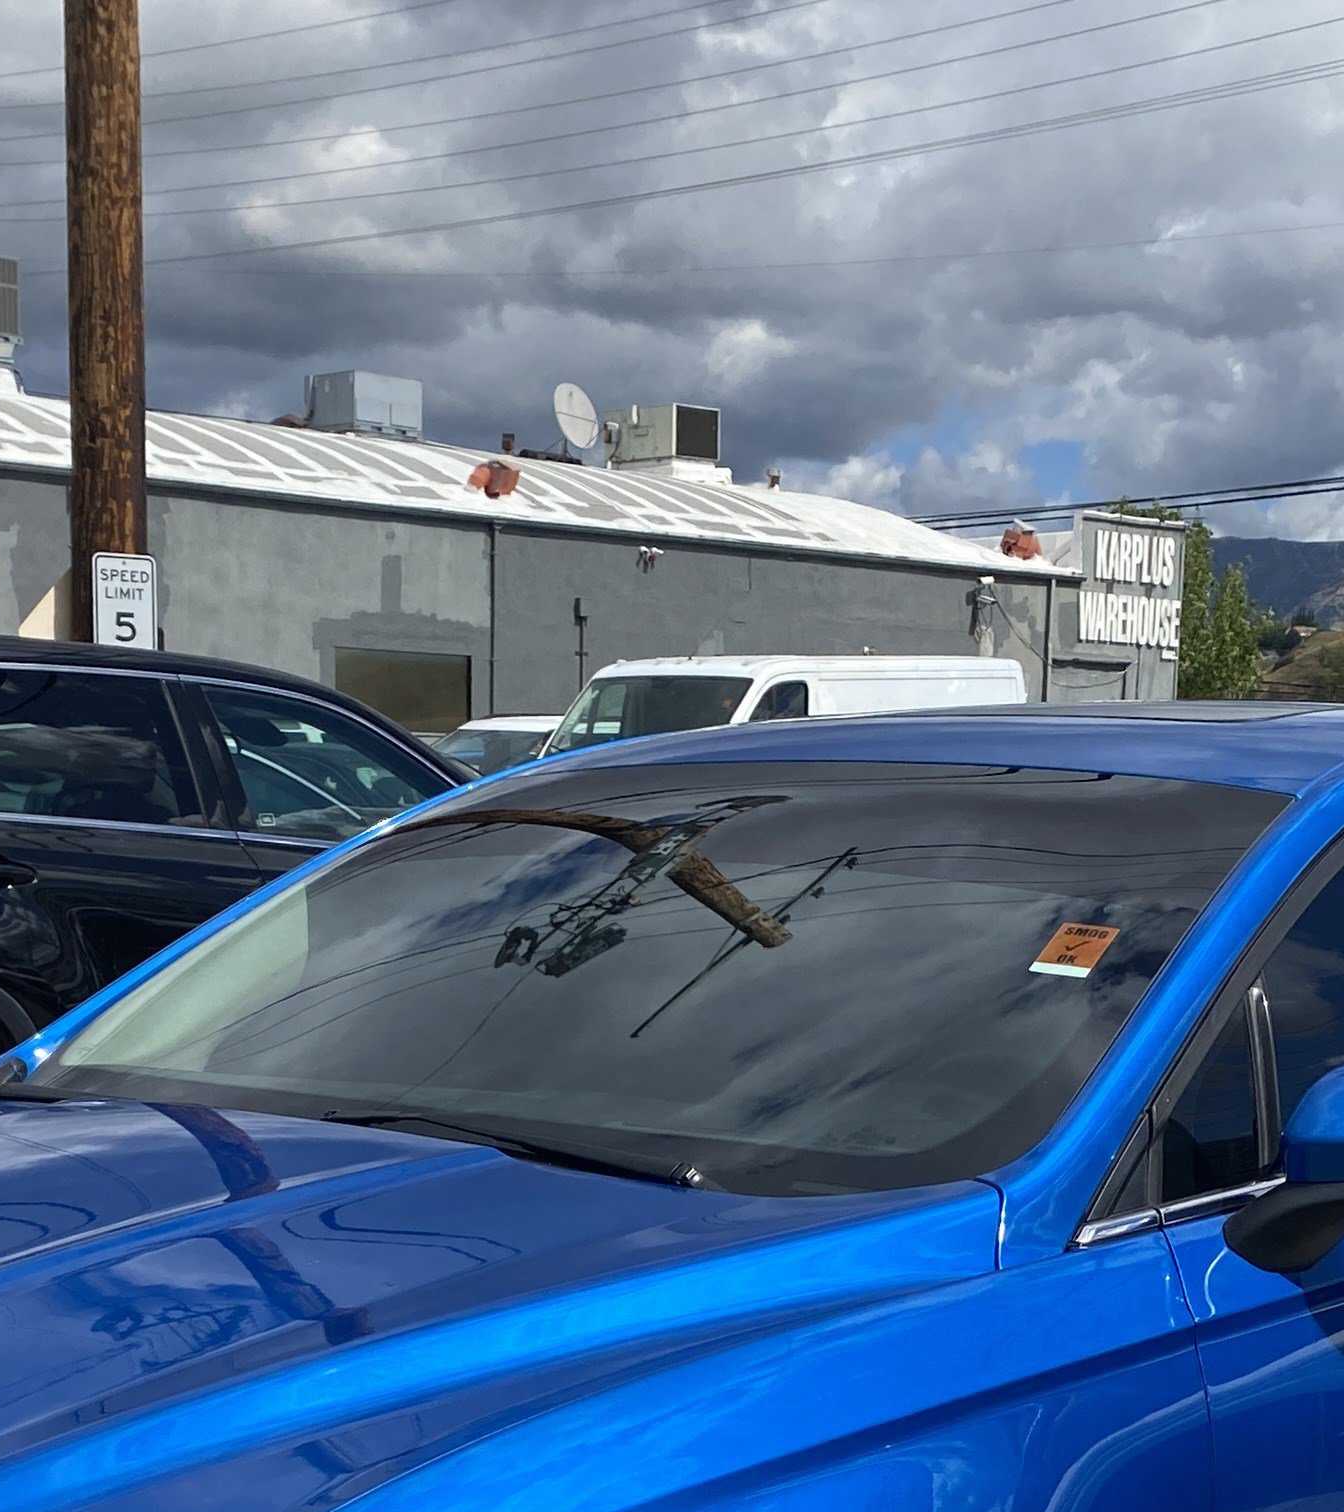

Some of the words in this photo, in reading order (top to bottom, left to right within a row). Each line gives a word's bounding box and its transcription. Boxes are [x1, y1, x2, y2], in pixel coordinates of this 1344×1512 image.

[1096, 529, 1175, 586] KARPLUS
[100, 568, 150, 583] SPEED
[105, 586, 144, 600] LIMIT
[115, 612, 136, 641] 5
[1079, 591, 1182, 647] WAREHOUSE
[1065, 927, 1109, 939] SMOG
[1057, 955, 1078, 964] OK
